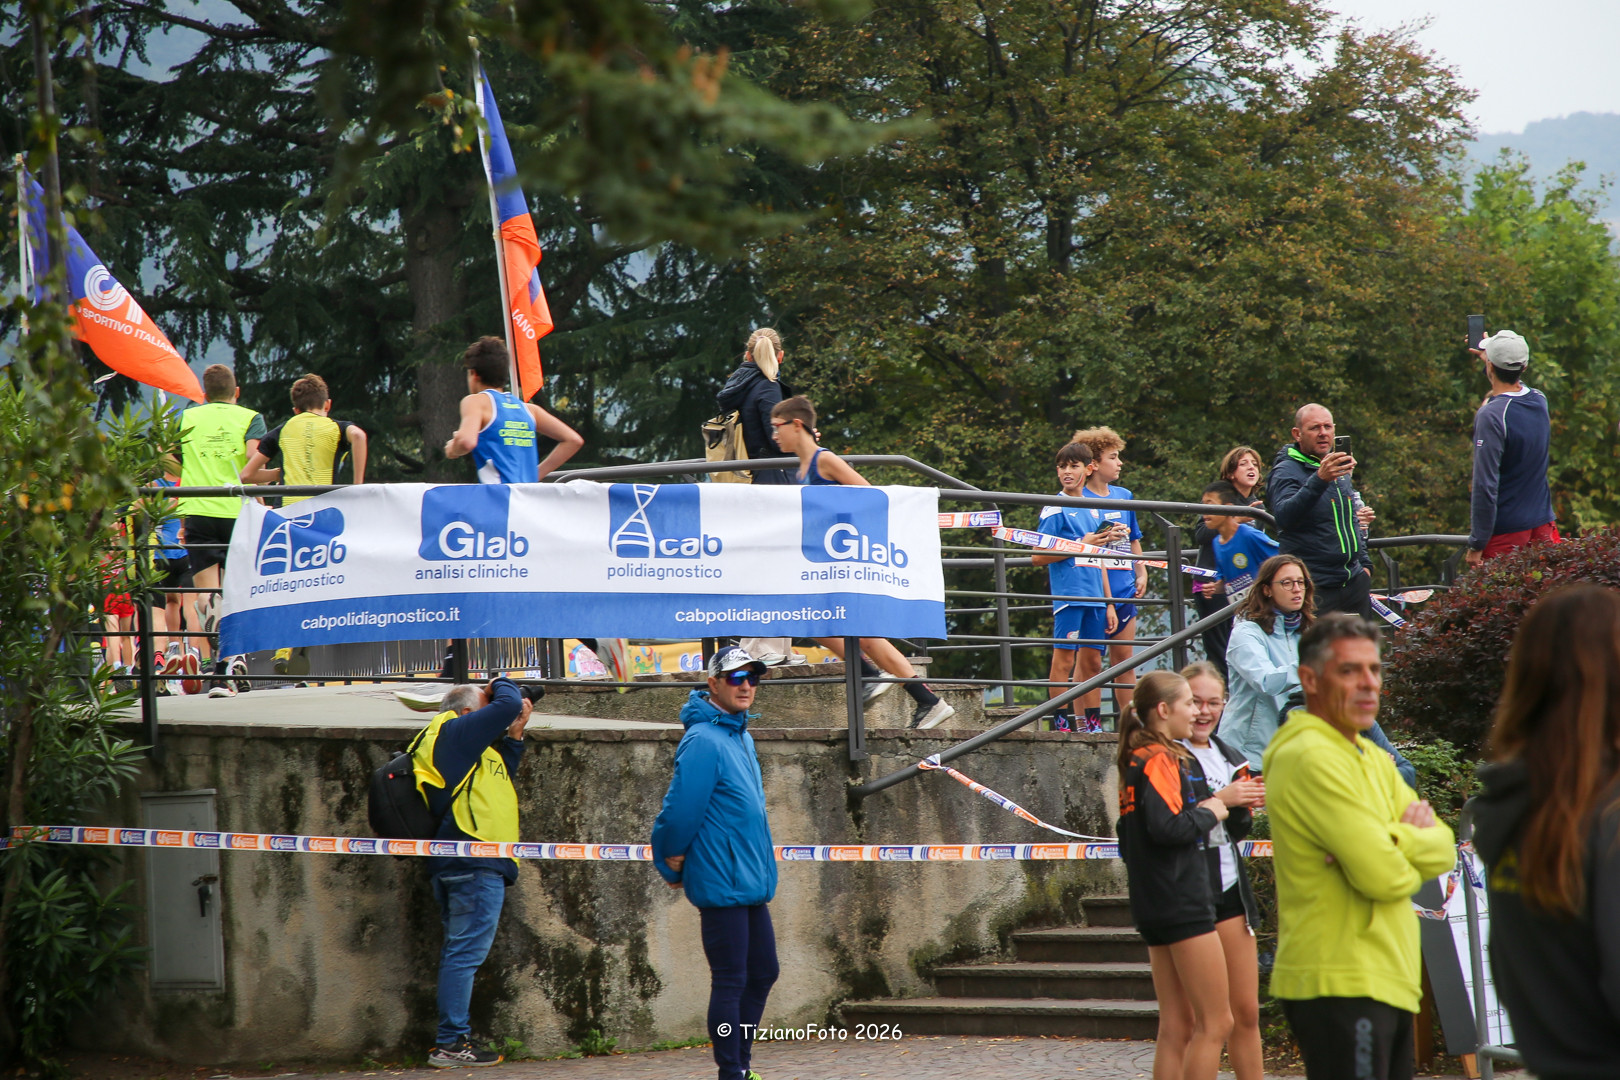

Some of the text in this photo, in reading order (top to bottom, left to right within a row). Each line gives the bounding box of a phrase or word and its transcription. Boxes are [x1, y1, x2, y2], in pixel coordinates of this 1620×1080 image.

[82, 307, 133, 335] SPORTIVO
[438, 521, 530, 560] Glab
[658, 534, 723, 557] cab
[823, 522, 909, 569] Glab
[293, 537, 347, 570] cab
[250, 571, 346, 598] polidiagnostico
[415, 563, 529, 581] analisi cliniche
[607, 563, 723, 581] polidiagnostico
[800, 566, 910, 588] analisi cliniche
[301, 606, 461, 631] cabpolidiagnostico.it
[674, 605, 847, 625] cabpolidiagnostico.it
